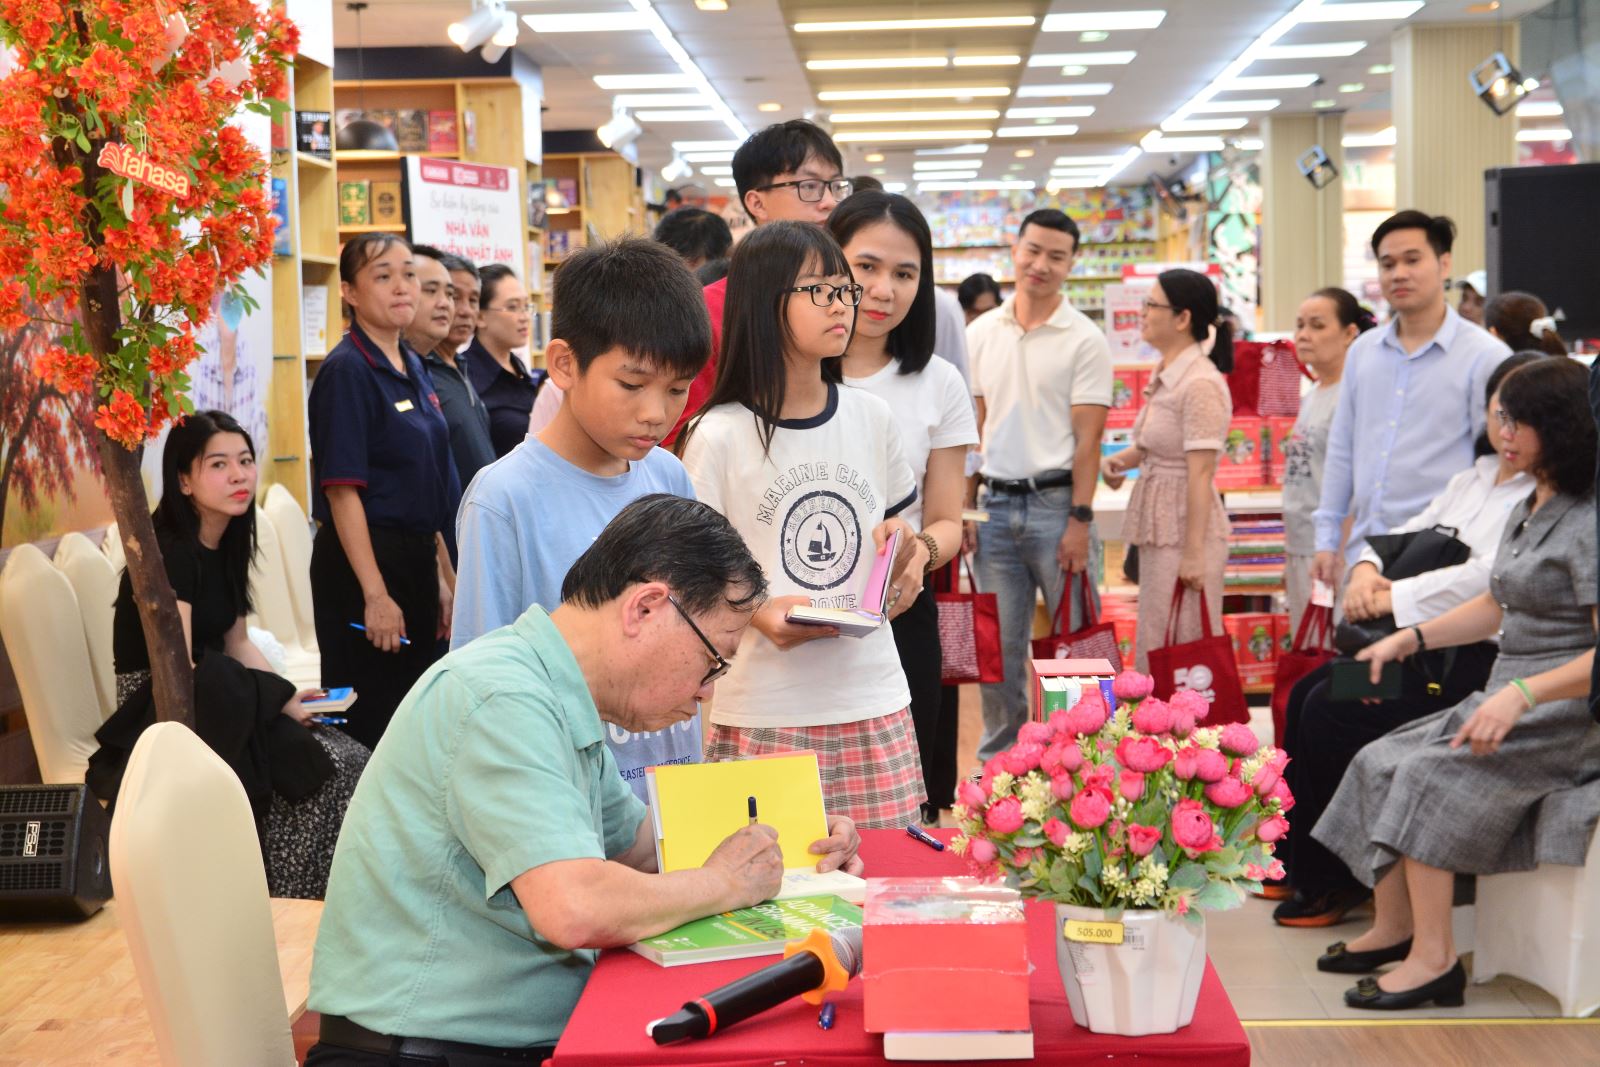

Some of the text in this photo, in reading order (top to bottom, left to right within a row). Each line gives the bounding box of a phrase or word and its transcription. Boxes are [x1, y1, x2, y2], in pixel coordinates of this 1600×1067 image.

[121, 147, 188, 197] fahasa
[757, 462, 829, 525] MARINE
[1076, 927, 1113, 938] 505.000
